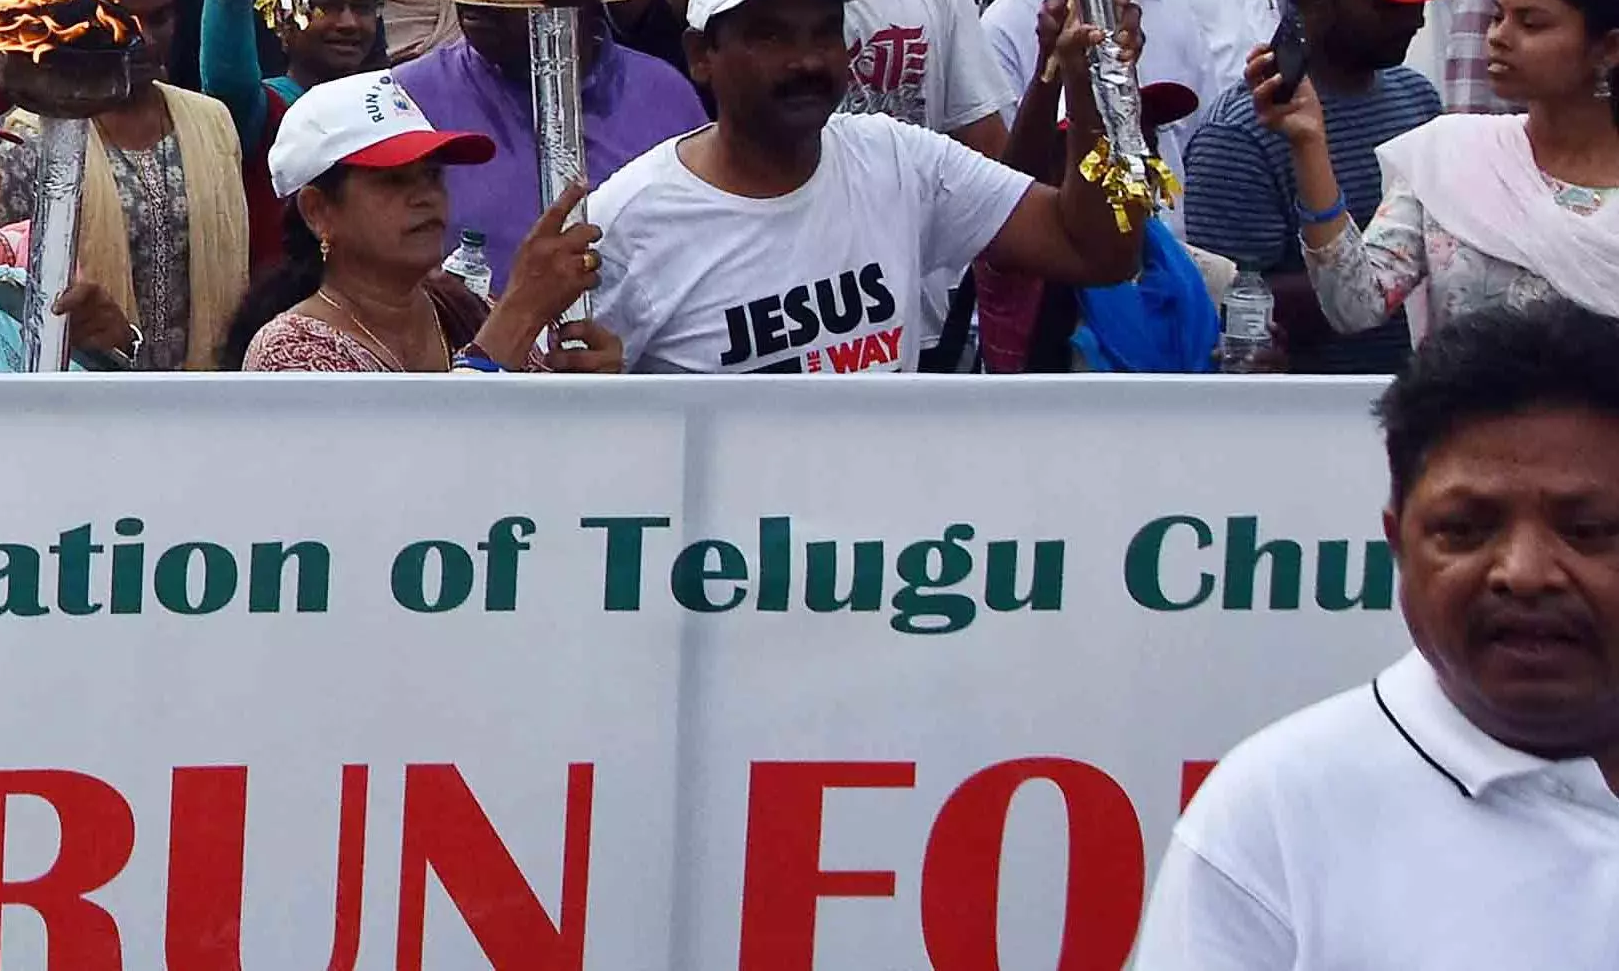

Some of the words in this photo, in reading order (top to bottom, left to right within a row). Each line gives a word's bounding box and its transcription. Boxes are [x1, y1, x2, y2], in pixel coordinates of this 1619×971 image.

[365, 92, 386, 123] RUN
[720, 262, 896, 367] JESUS
[825, 325, 904, 374] WAY
[389, 516, 537, 613] of
[581, 516, 1066, 635] Telugu
[1123, 514, 1395, 613] Chu
[737, 756, 1194, 971] FO
